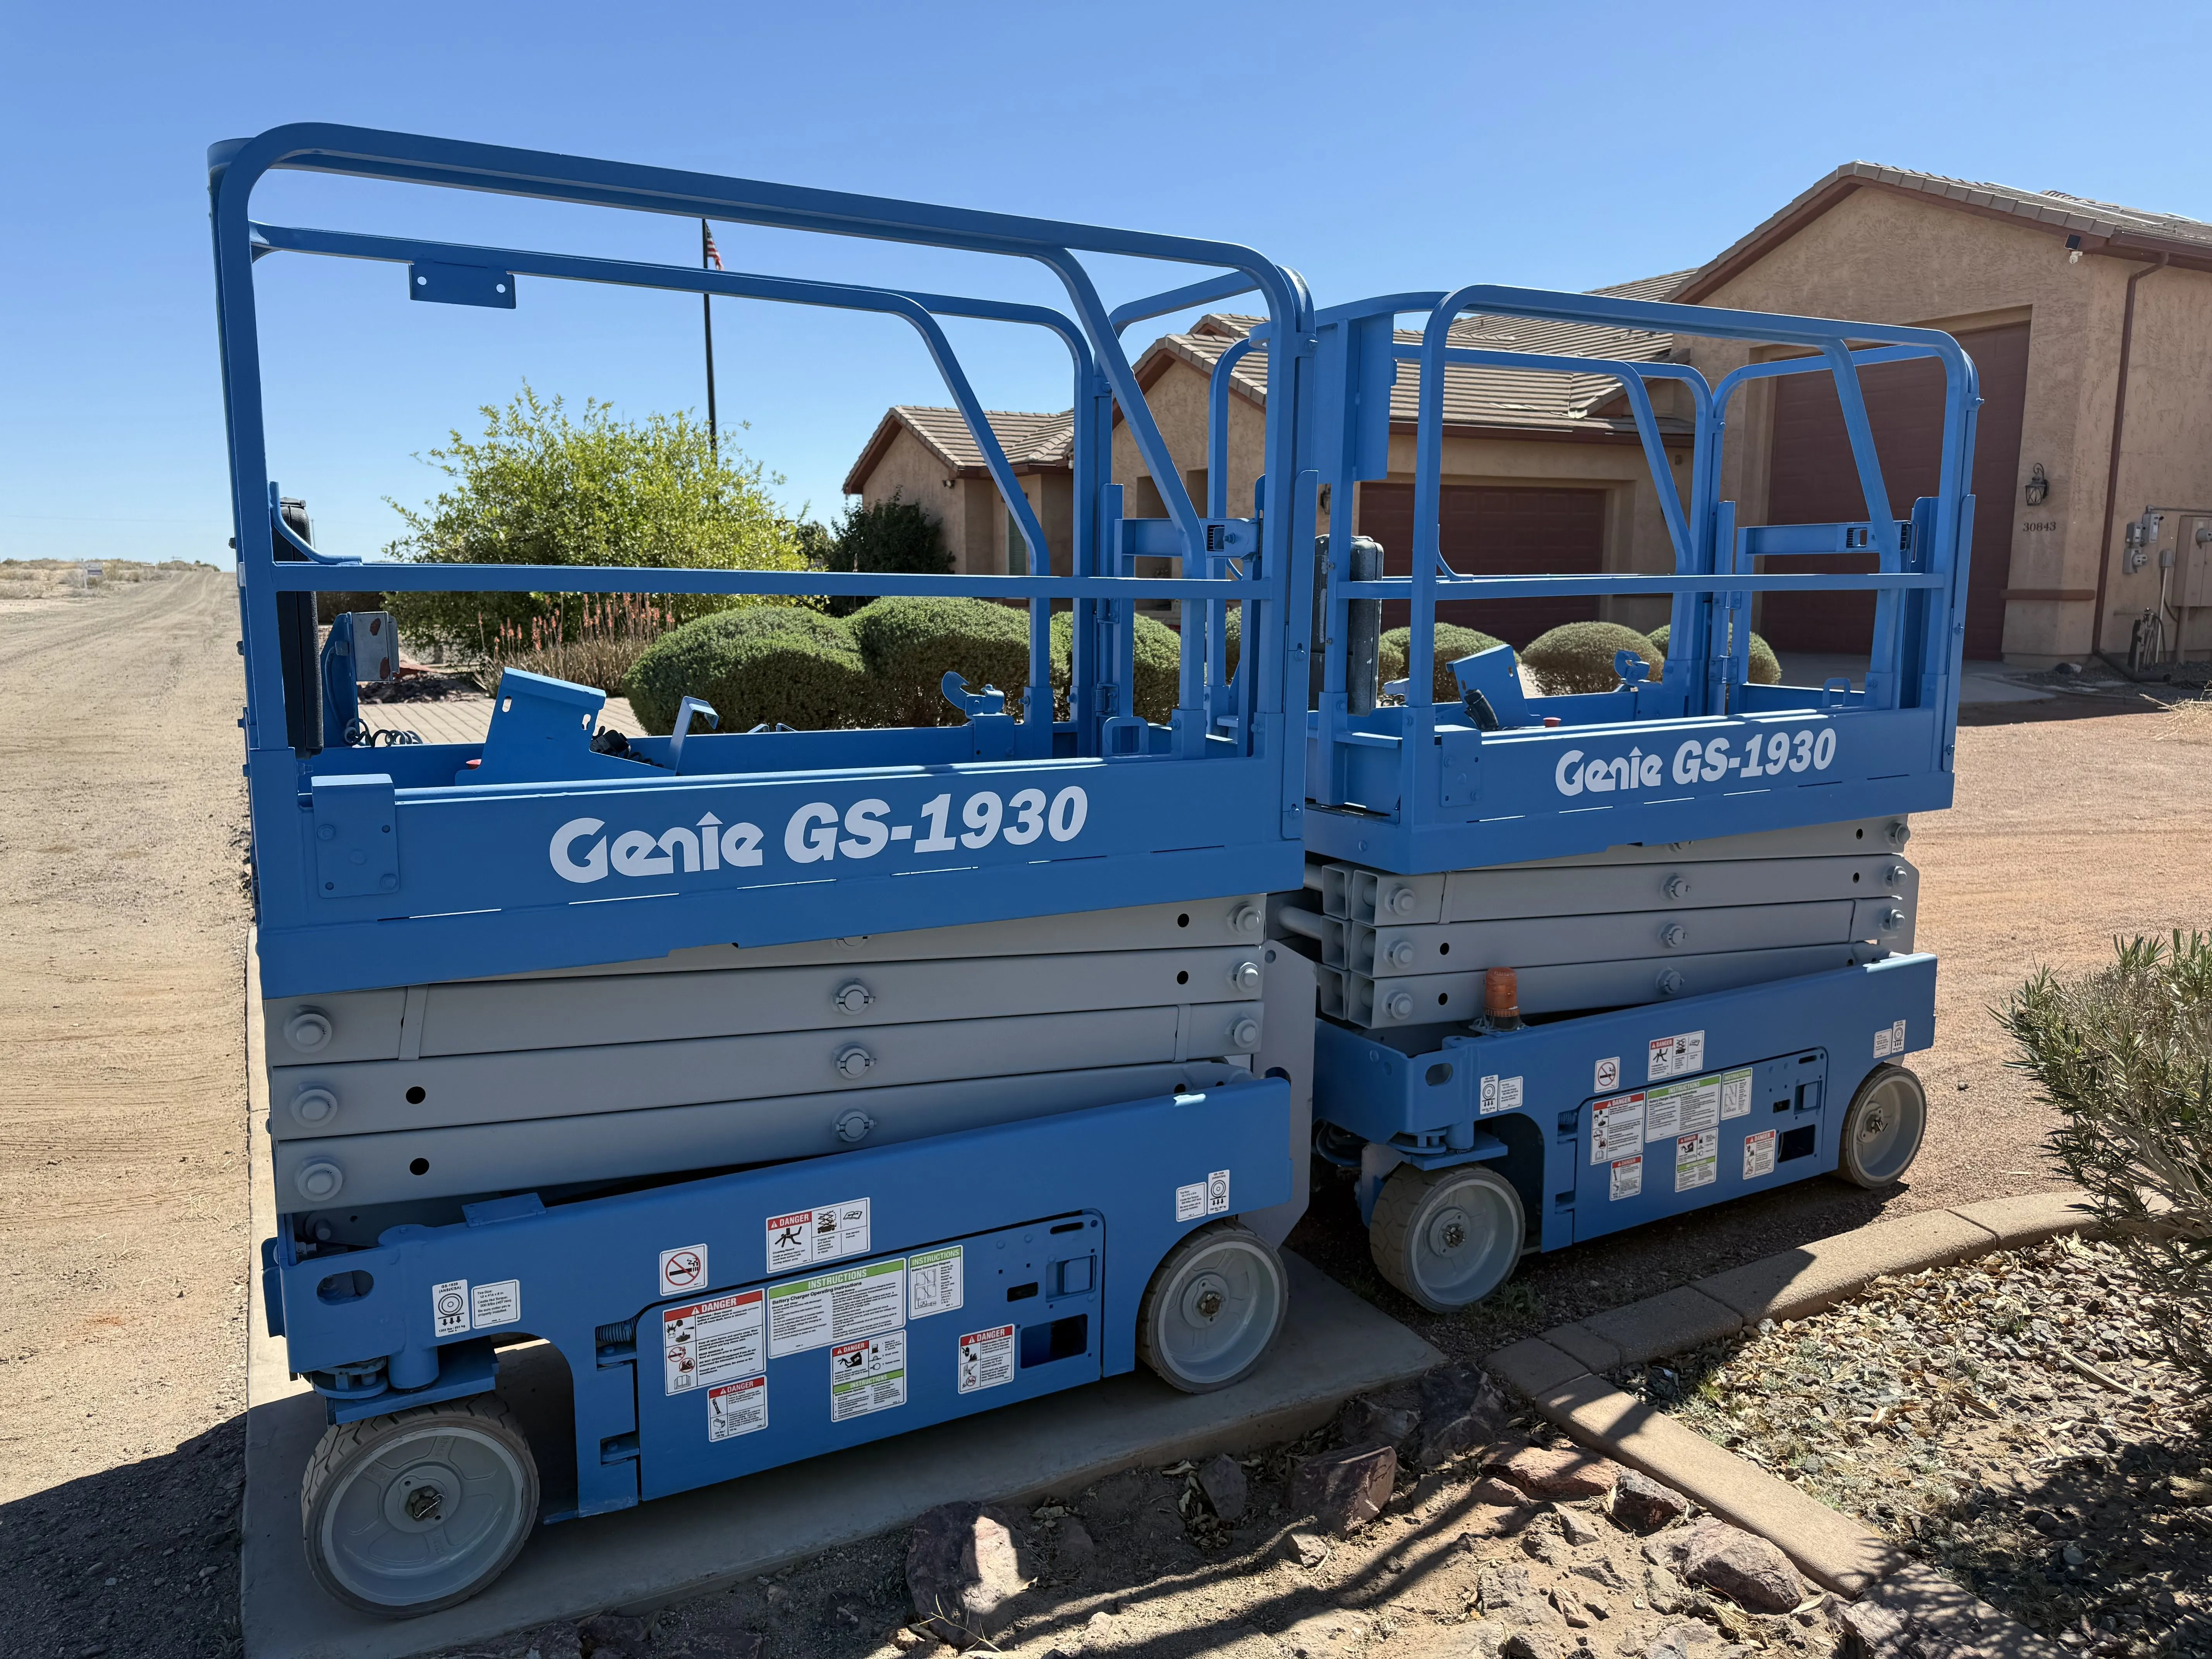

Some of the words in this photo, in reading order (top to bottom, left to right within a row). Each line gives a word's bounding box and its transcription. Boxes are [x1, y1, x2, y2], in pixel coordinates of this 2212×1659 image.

[2023, 522, 2056, 532] 30843
[1555, 746, 1663, 796] Genie
[1673, 728, 1836, 785] GS-1930
[549, 811, 764, 883] Genie
[784, 786, 1087, 864] GS-1930
[1668, 1081, 1700, 1093] INSTRUCTIONS
[1612, 1097, 1631, 1106] DANGER
[780, 1213, 809, 1226] DANGER
[912, 1249, 959, 1266] INSTRUCTIONS
[808, 1269, 866, 1289] INSTRUCTIONS
[790, 1293, 809, 1301] Charger
[811, 1287, 833, 1297] Operating
[834, 1281, 862, 1291] Instructions
[701, 1298, 736, 1312] DANGER
[977, 1328, 1005, 1341] DANGER
[843, 1343, 865, 1353] DANGER
[727, 1381, 753, 1393] DANGER
[850, 1374, 887, 1389] INSTRUCTIONS
